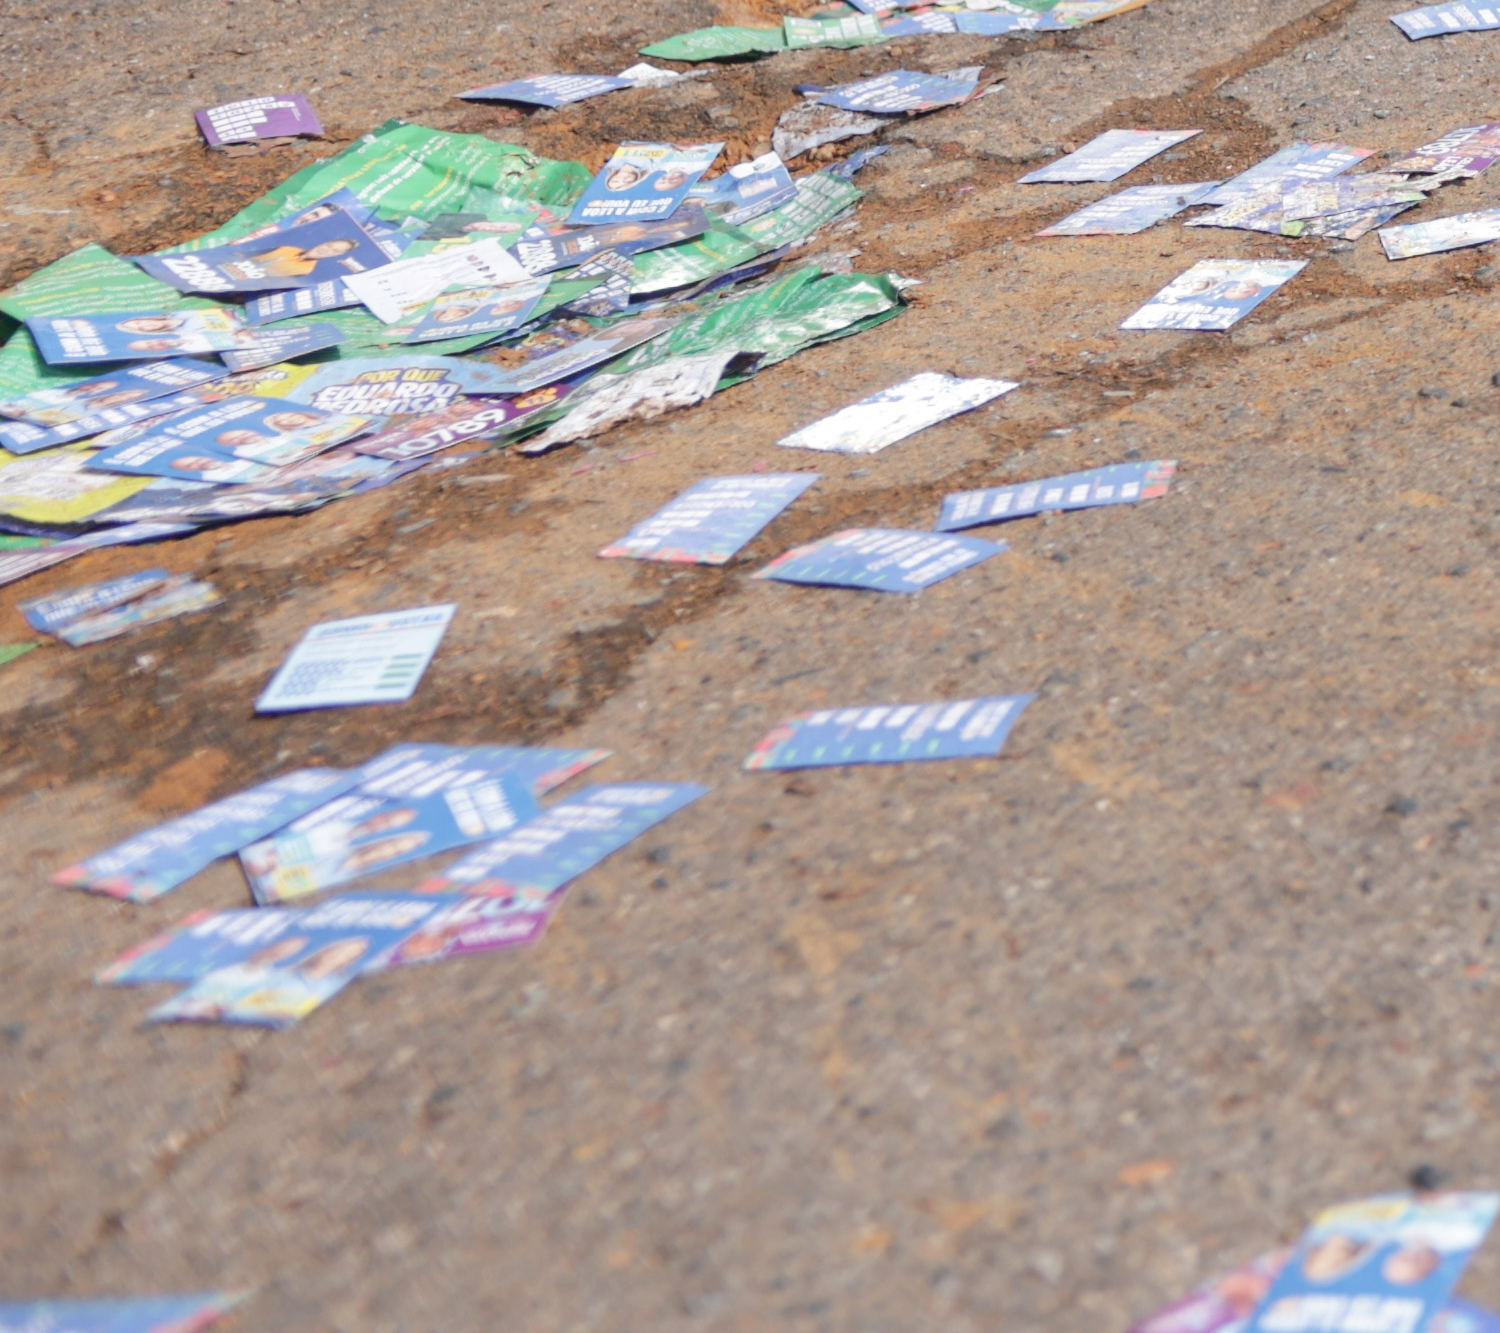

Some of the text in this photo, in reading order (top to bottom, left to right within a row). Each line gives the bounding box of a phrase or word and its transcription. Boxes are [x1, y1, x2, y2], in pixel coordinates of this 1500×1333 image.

[401, 367, 446, 382] QUE
[317, 381, 458, 401] EDUARDO
[377, 409, 506, 457] 10789
